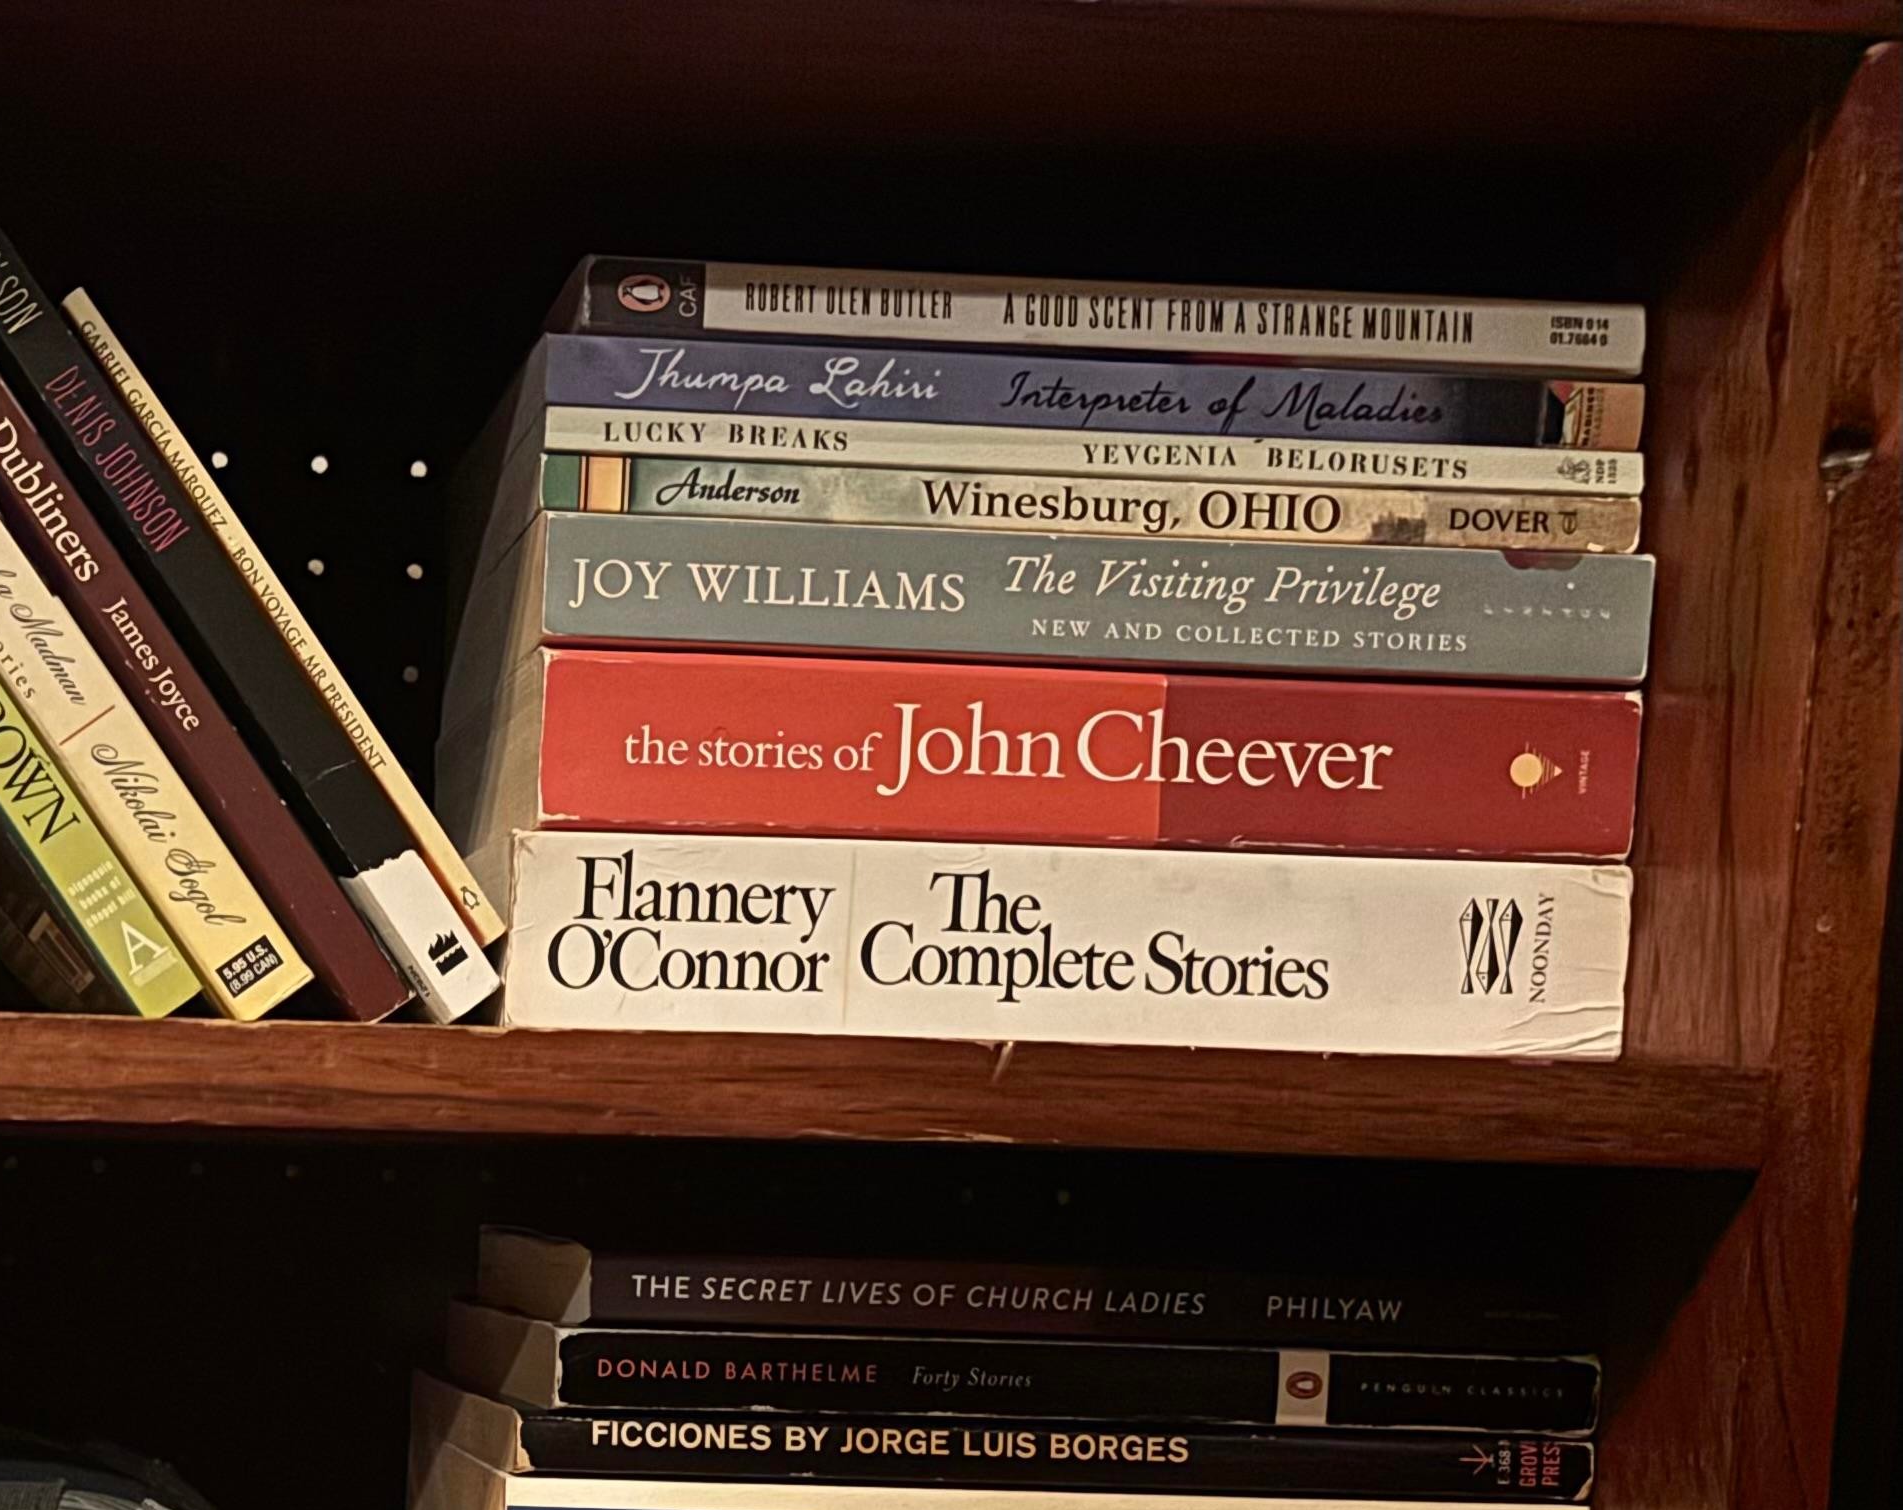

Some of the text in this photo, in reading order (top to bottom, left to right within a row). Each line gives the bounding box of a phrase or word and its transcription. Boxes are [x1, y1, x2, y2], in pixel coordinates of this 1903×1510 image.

[568, 558, 966, 613] JOY WILLIAMS
[1004, 554, 1443, 621] The Visiting Privilege
[102, 597, 159, 673] James
[148, 667, 200, 732] Joyce
[1032, 619, 1469, 652] NEW AND COLLECTED STORIES
[624, 700, 1394, 797] the stories of John Cheever
[572, 848, 837, 943] Flannery
[929, 868, 1041, 936] The
[223, 944, 269, 979] 5.95 U.S.
[859, 920, 1330, 1004] Complete Stories
[1528, 892, 1556, 1004] NOONDAY
[597, 1358, 879, 1384] DONALD BARTHELME
[591, 1420, 1189, 1463] FICCIONES BY JORGE LUIS BORGES
